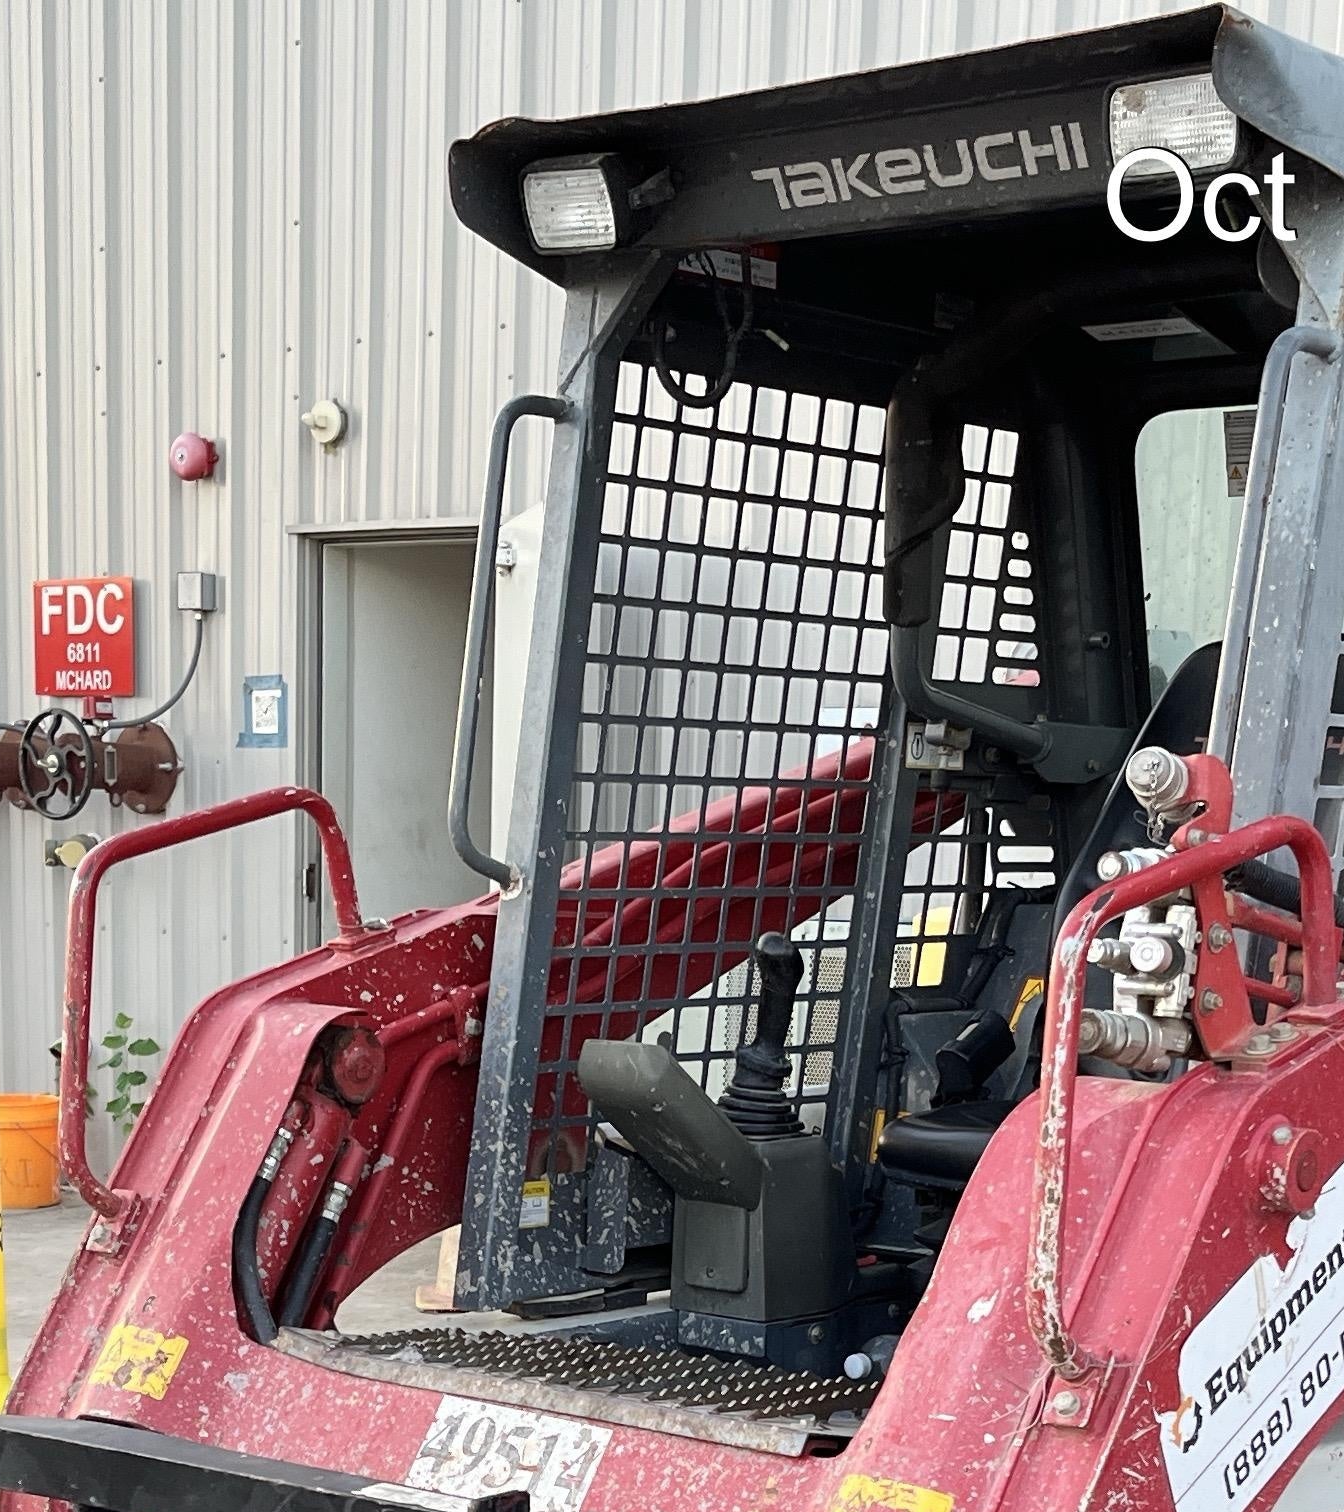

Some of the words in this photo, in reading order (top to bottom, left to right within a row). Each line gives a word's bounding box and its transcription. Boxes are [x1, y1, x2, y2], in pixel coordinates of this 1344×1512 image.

[41, 583, 124, 635] FDC
[66, 642, 99, 662] 6811
[56, 669, 112, 690] MCHARD
[1222, 1398, 1295, 1500] (888)
